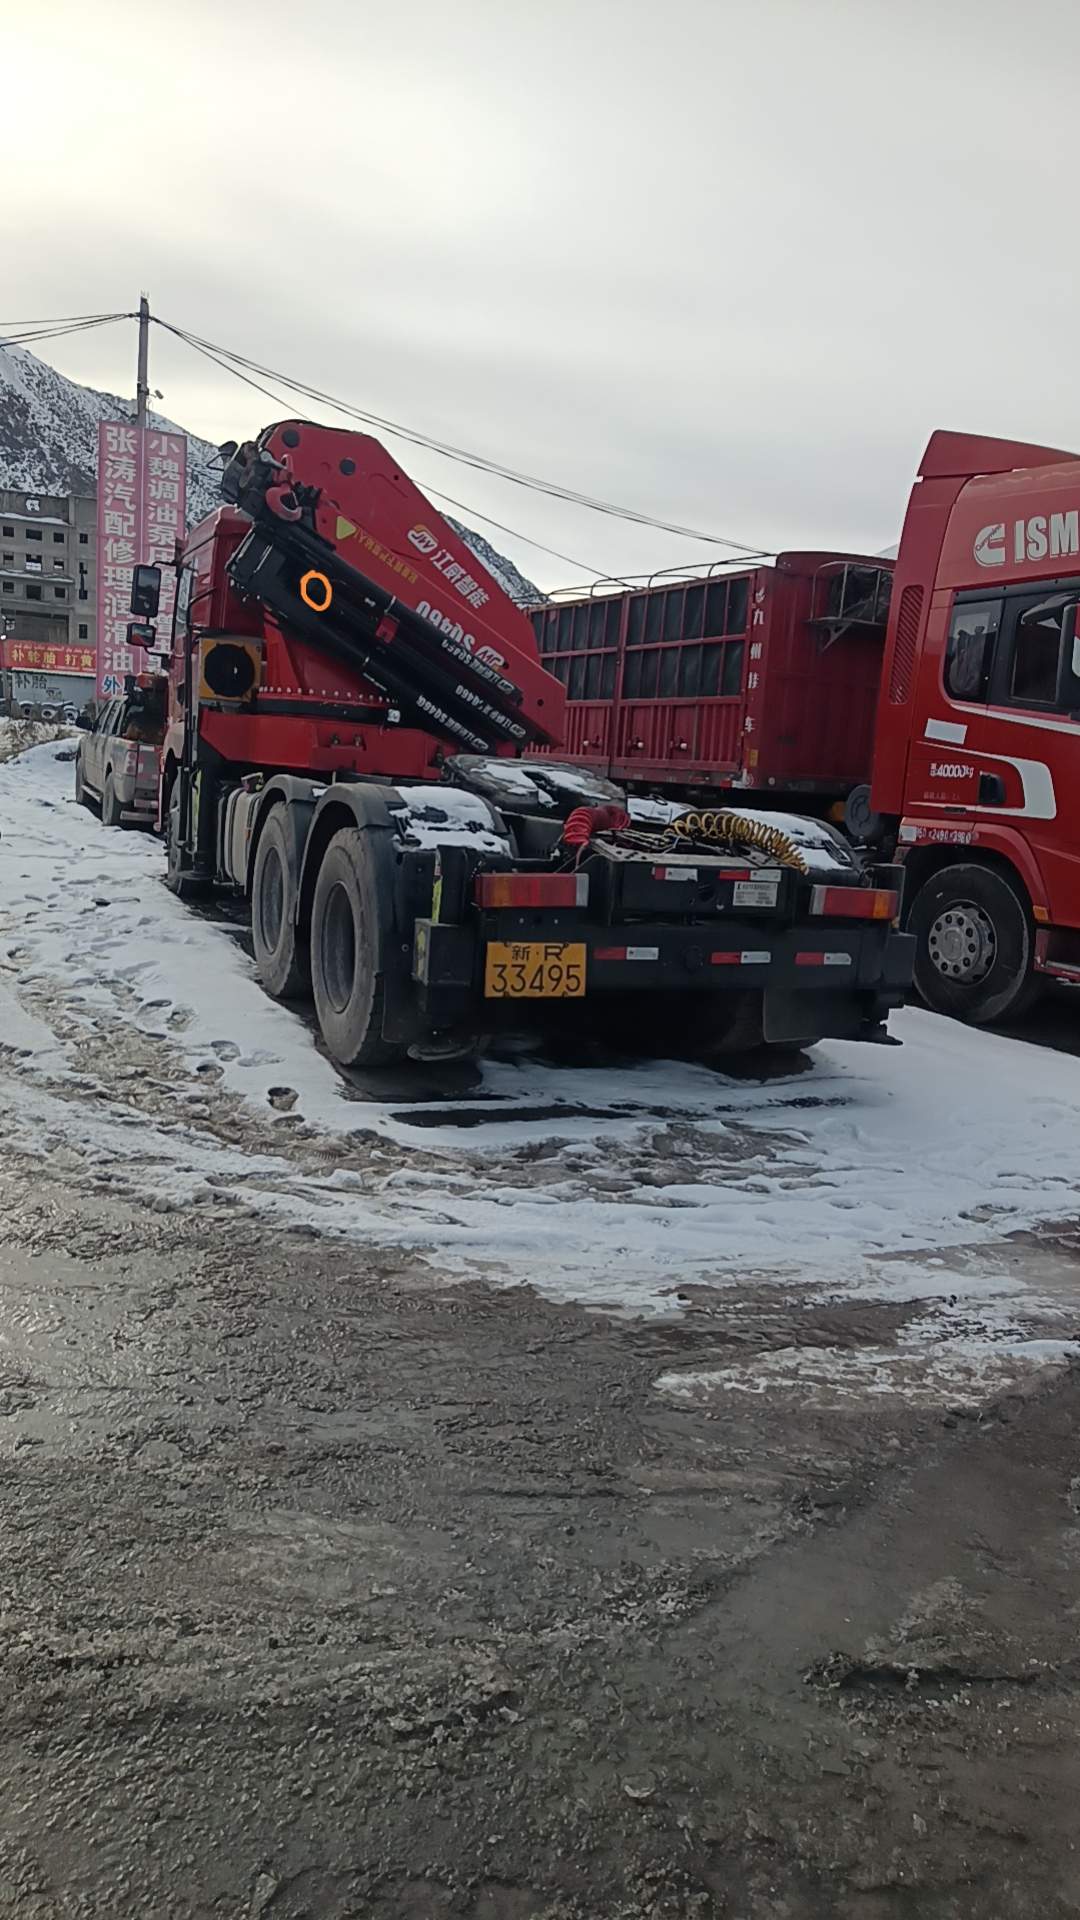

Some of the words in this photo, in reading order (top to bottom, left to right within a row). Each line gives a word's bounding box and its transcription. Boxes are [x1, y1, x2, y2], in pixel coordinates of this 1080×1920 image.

[103, 426, 137, 672] 张涛汽配修理润滑油
[430, 549, 490, 609] 江威智能
[11, 648, 56, 664] 补轮胎
[15, 673, 48, 690] 补胎
[491, 964, 581, 992] 33495
